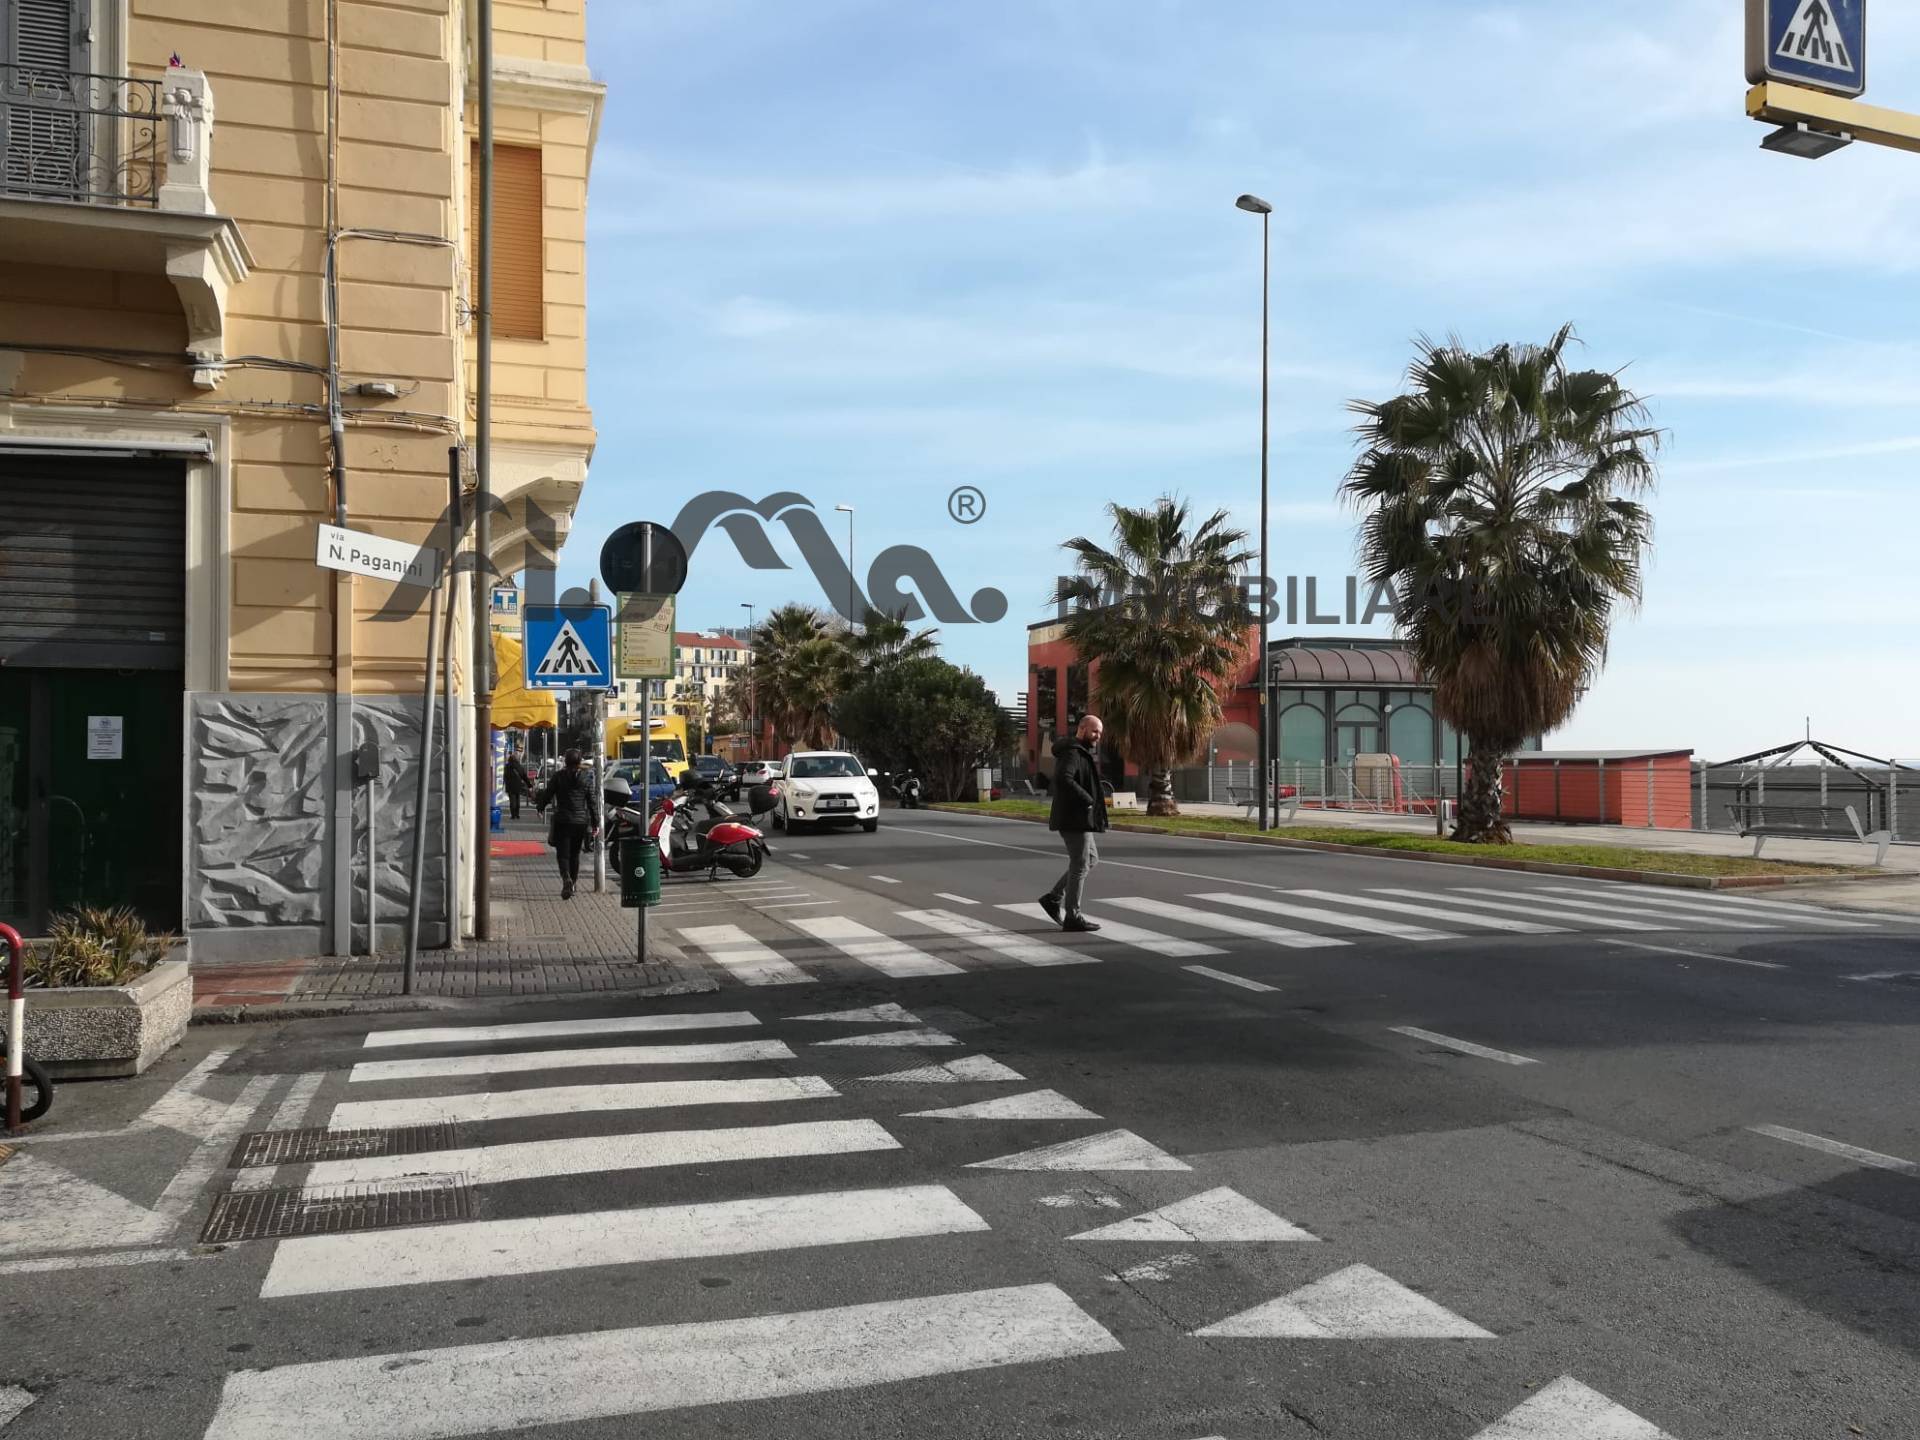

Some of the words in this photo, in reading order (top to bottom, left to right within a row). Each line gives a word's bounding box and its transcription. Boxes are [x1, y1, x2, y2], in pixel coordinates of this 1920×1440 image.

[330, 531, 345, 541] via
[329, 544, 345, 561] N.
[350, 548, 422, 577] Paganini
